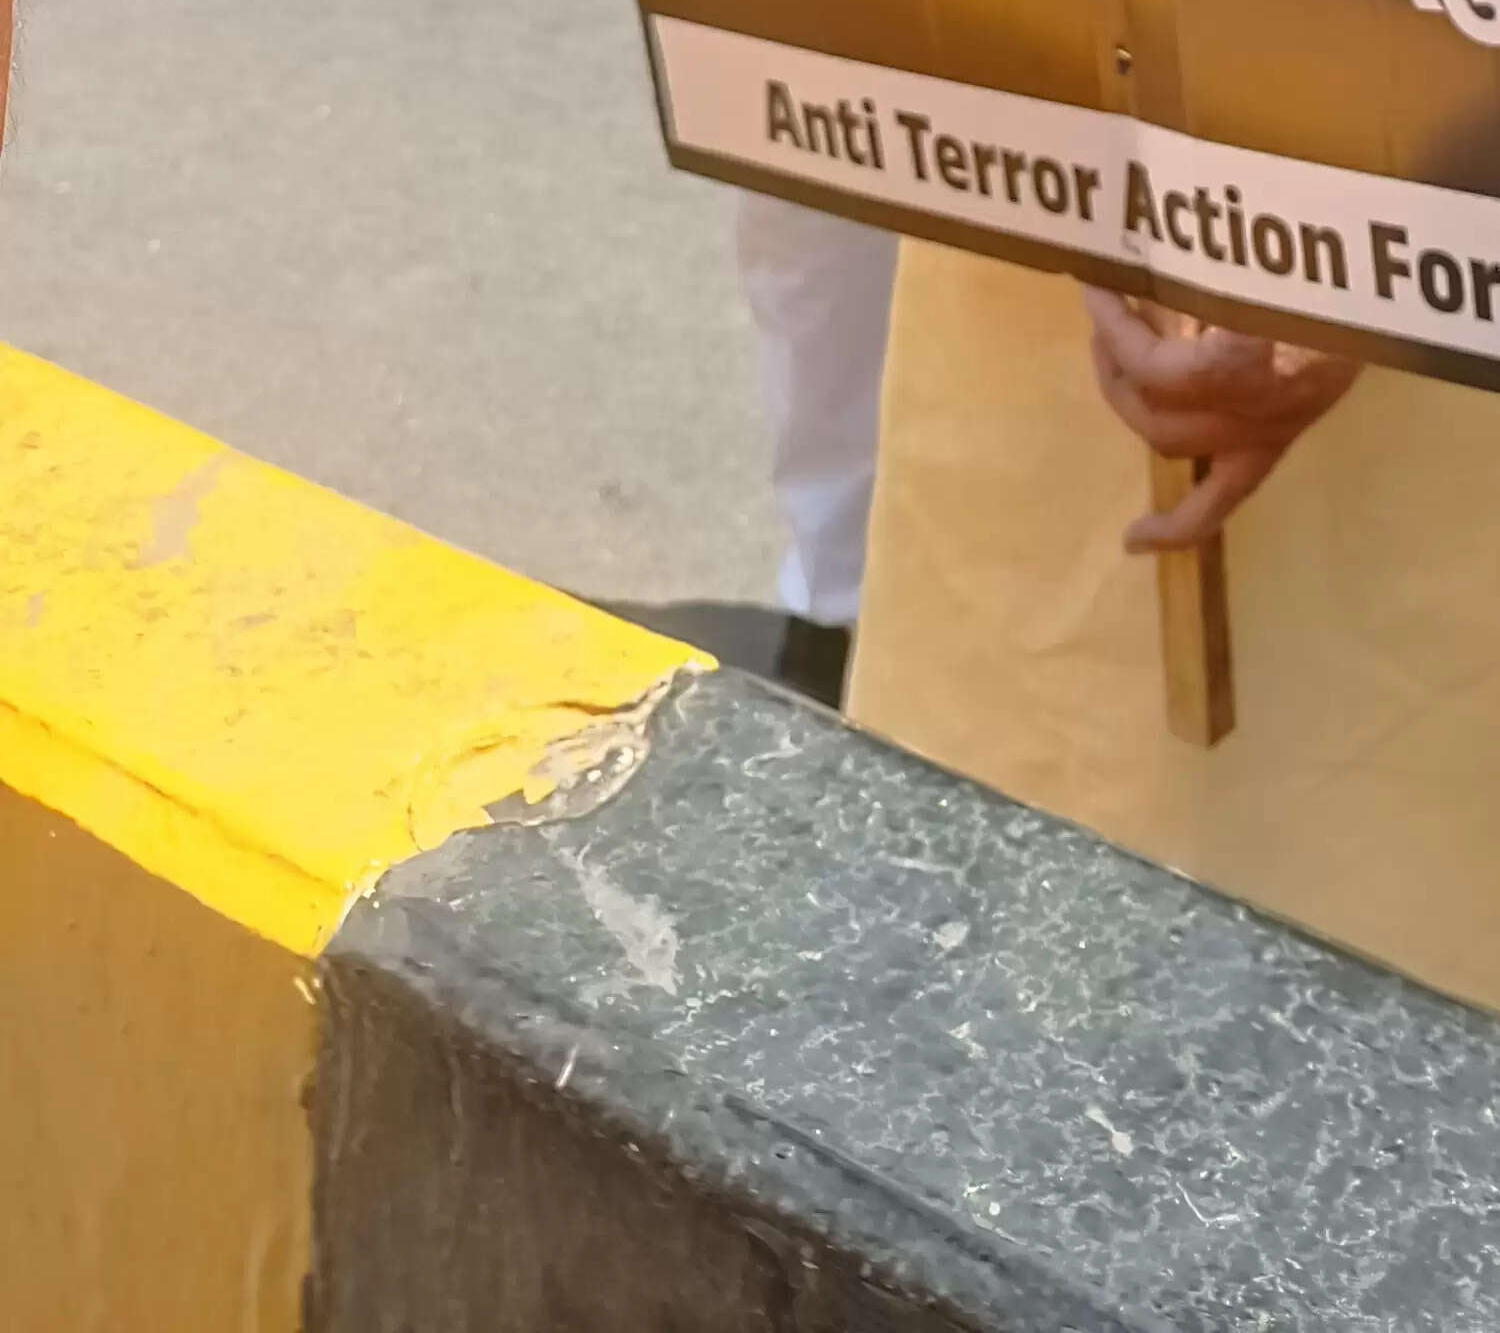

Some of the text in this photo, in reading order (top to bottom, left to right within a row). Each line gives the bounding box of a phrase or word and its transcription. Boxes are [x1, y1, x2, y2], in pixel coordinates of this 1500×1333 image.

[764, 77, 885, 171] Anti
[895, 110, 1101, 223] Terror
[1125, 159, 1351, 291] Action
